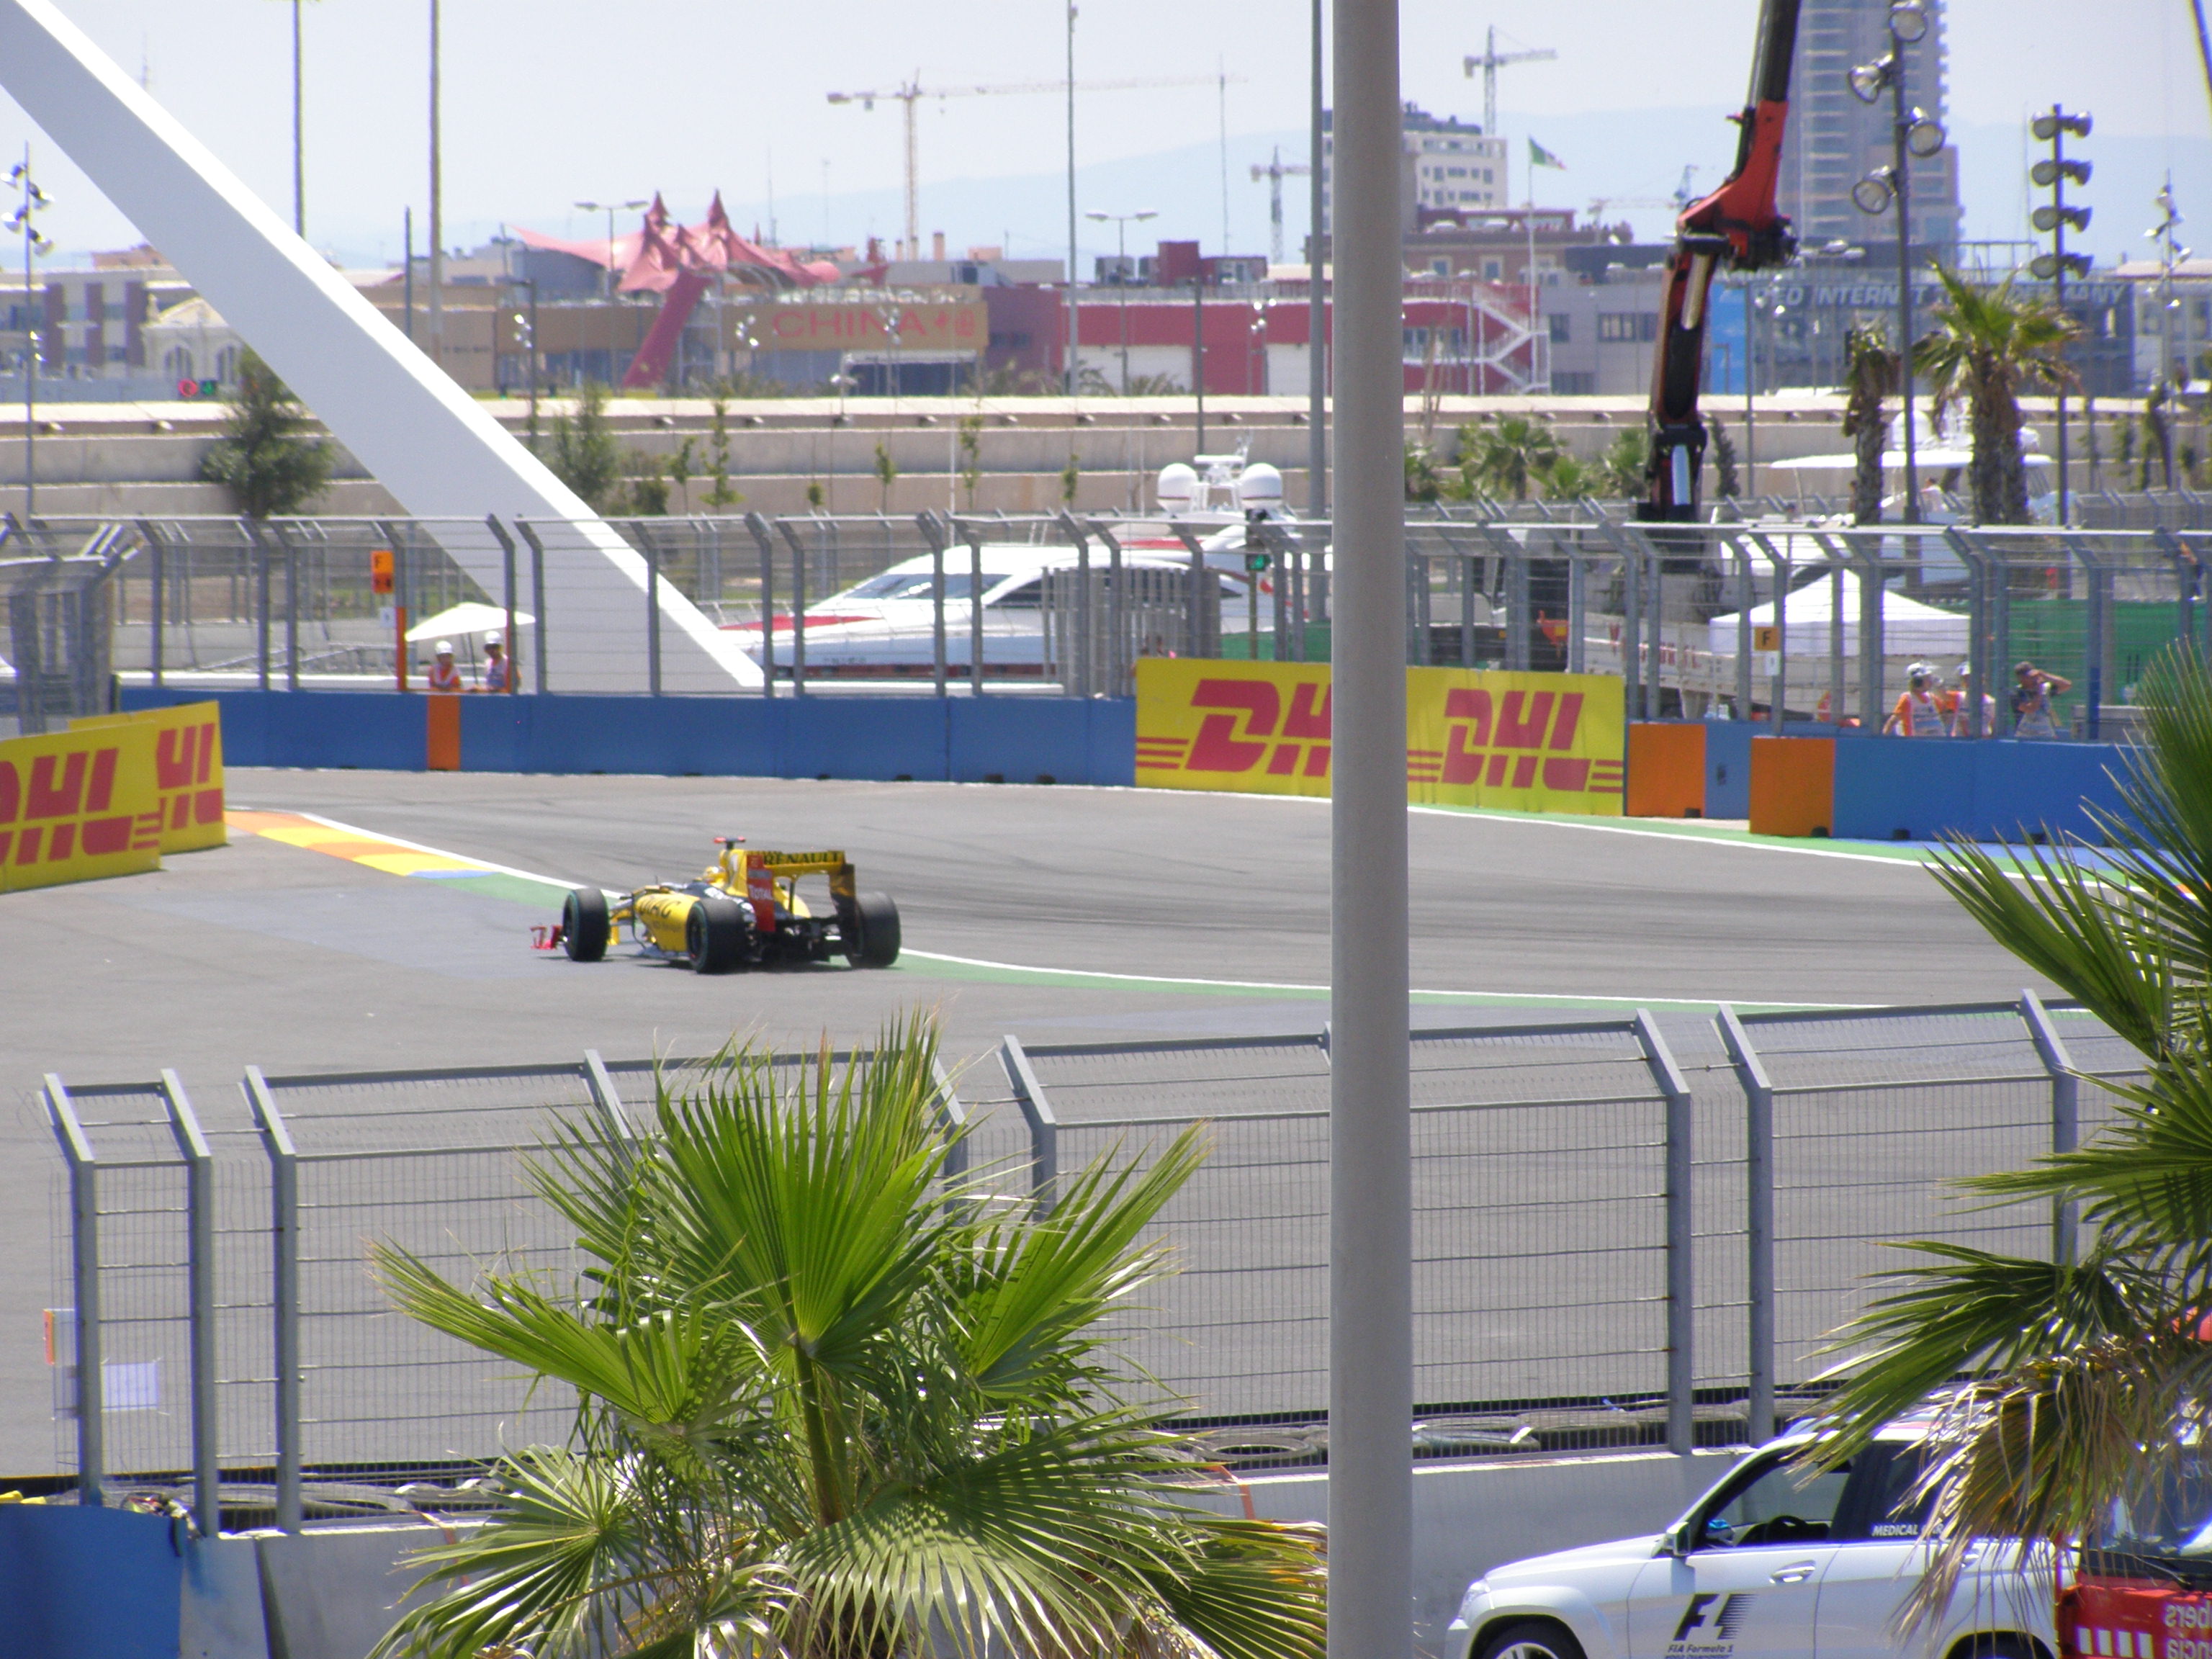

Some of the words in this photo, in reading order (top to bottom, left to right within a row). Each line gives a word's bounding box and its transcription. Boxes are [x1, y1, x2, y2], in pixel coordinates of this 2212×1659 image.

[1807, 286, 1927, 306] INTERNT
[772, 310, 927, 338] CHINA
[1762, 630, 1772, 646] F
[1184, 678, 1333, 778] DH
[1442, 688, 1591, 791] DHL
[763, 851, 842, 865] RENAULT
[749, 884, 773, 901] TOTAL
[1872, 1524, 1918, 1537] MEDICAL
[1673, 1593, 1760, 1641] F1
[1668, 1644, 1683, 1653] FIA
[1686, 1644, 1725, 1653] Formula
